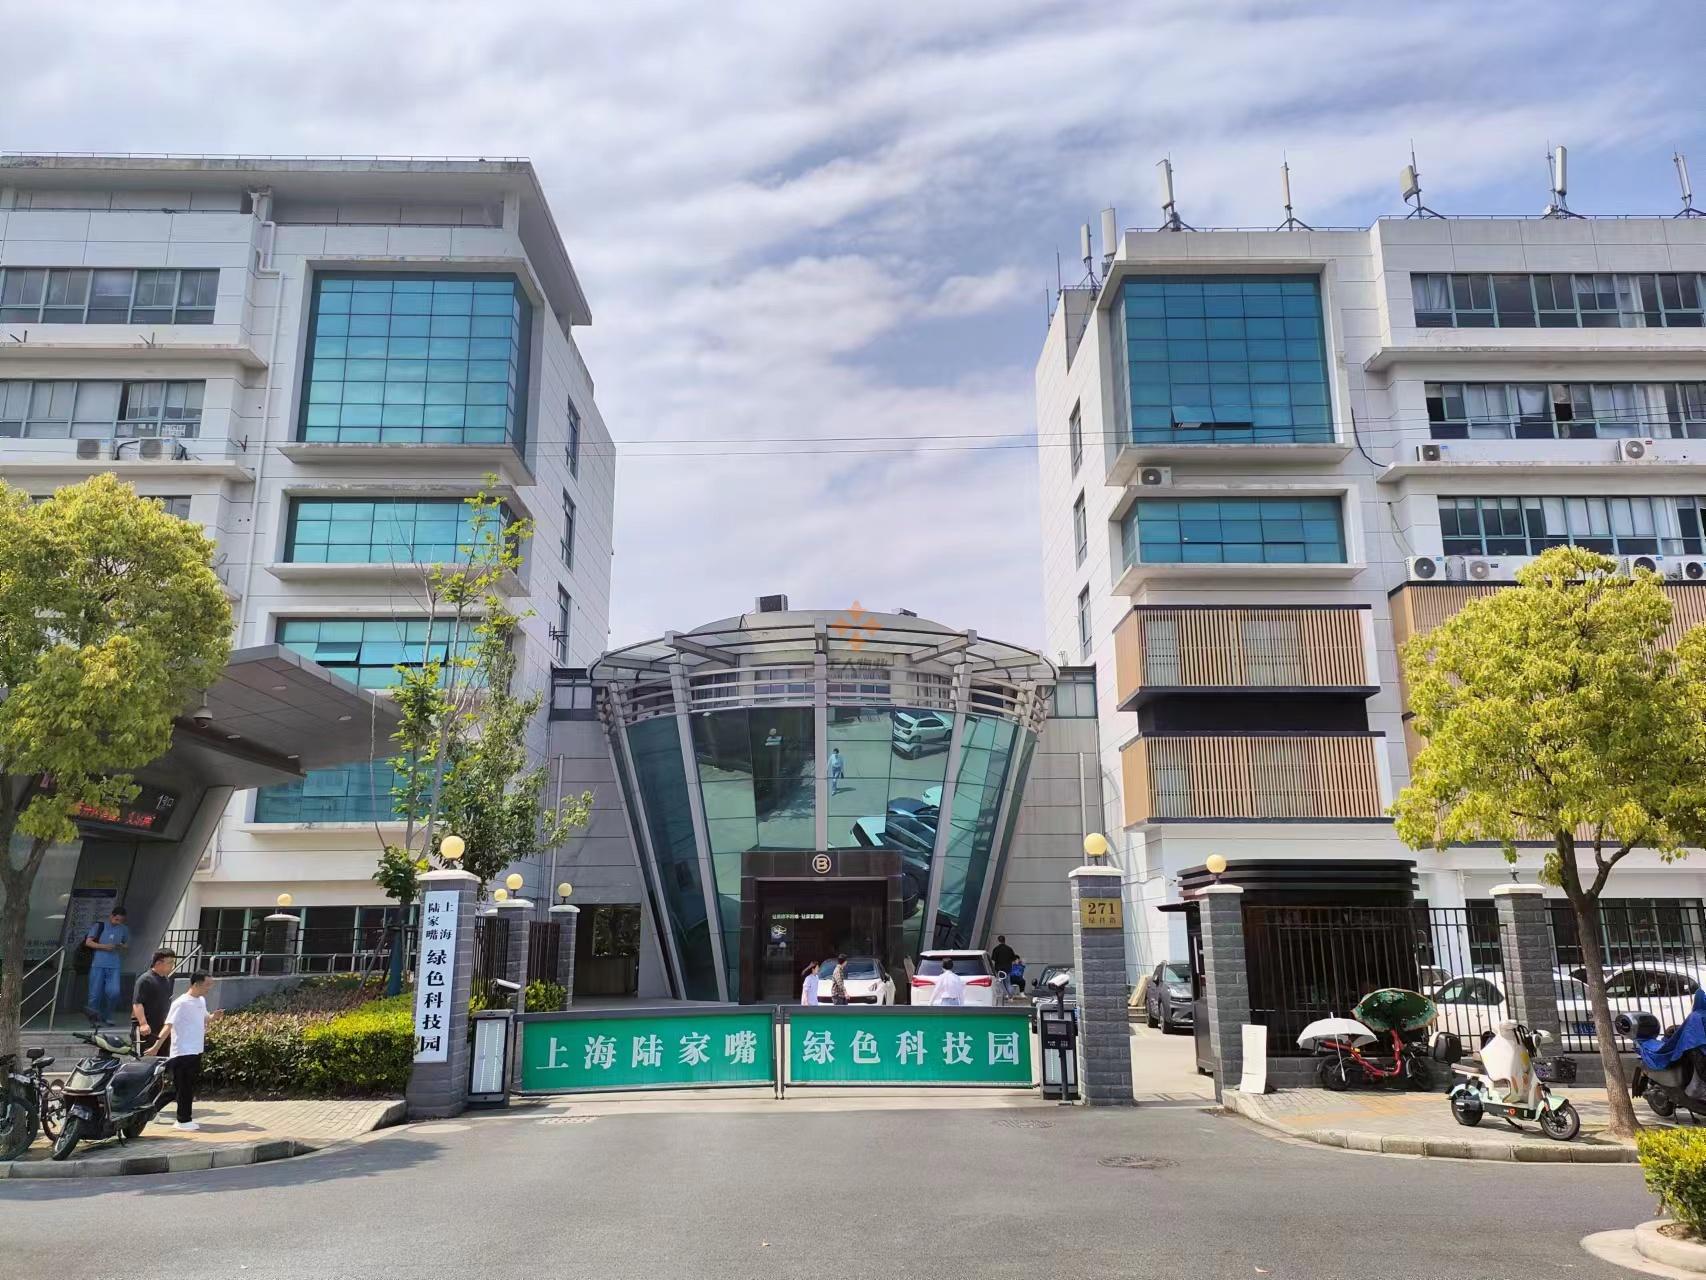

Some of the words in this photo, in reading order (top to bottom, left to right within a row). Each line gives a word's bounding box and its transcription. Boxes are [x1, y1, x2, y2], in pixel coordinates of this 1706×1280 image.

[816, 857, 828, 871] B
[425, 901, 440, 940] 陆家嘴
[441, 901, 454, 940] 上海
[1088, 902, 1115, 915] 271
[421, 949, 447, 1052] 绿色科技园
[535, 1030, 758, 1070] 上海陆家嘴
[802, 1030, 1020, 1066] 绿色科技园
